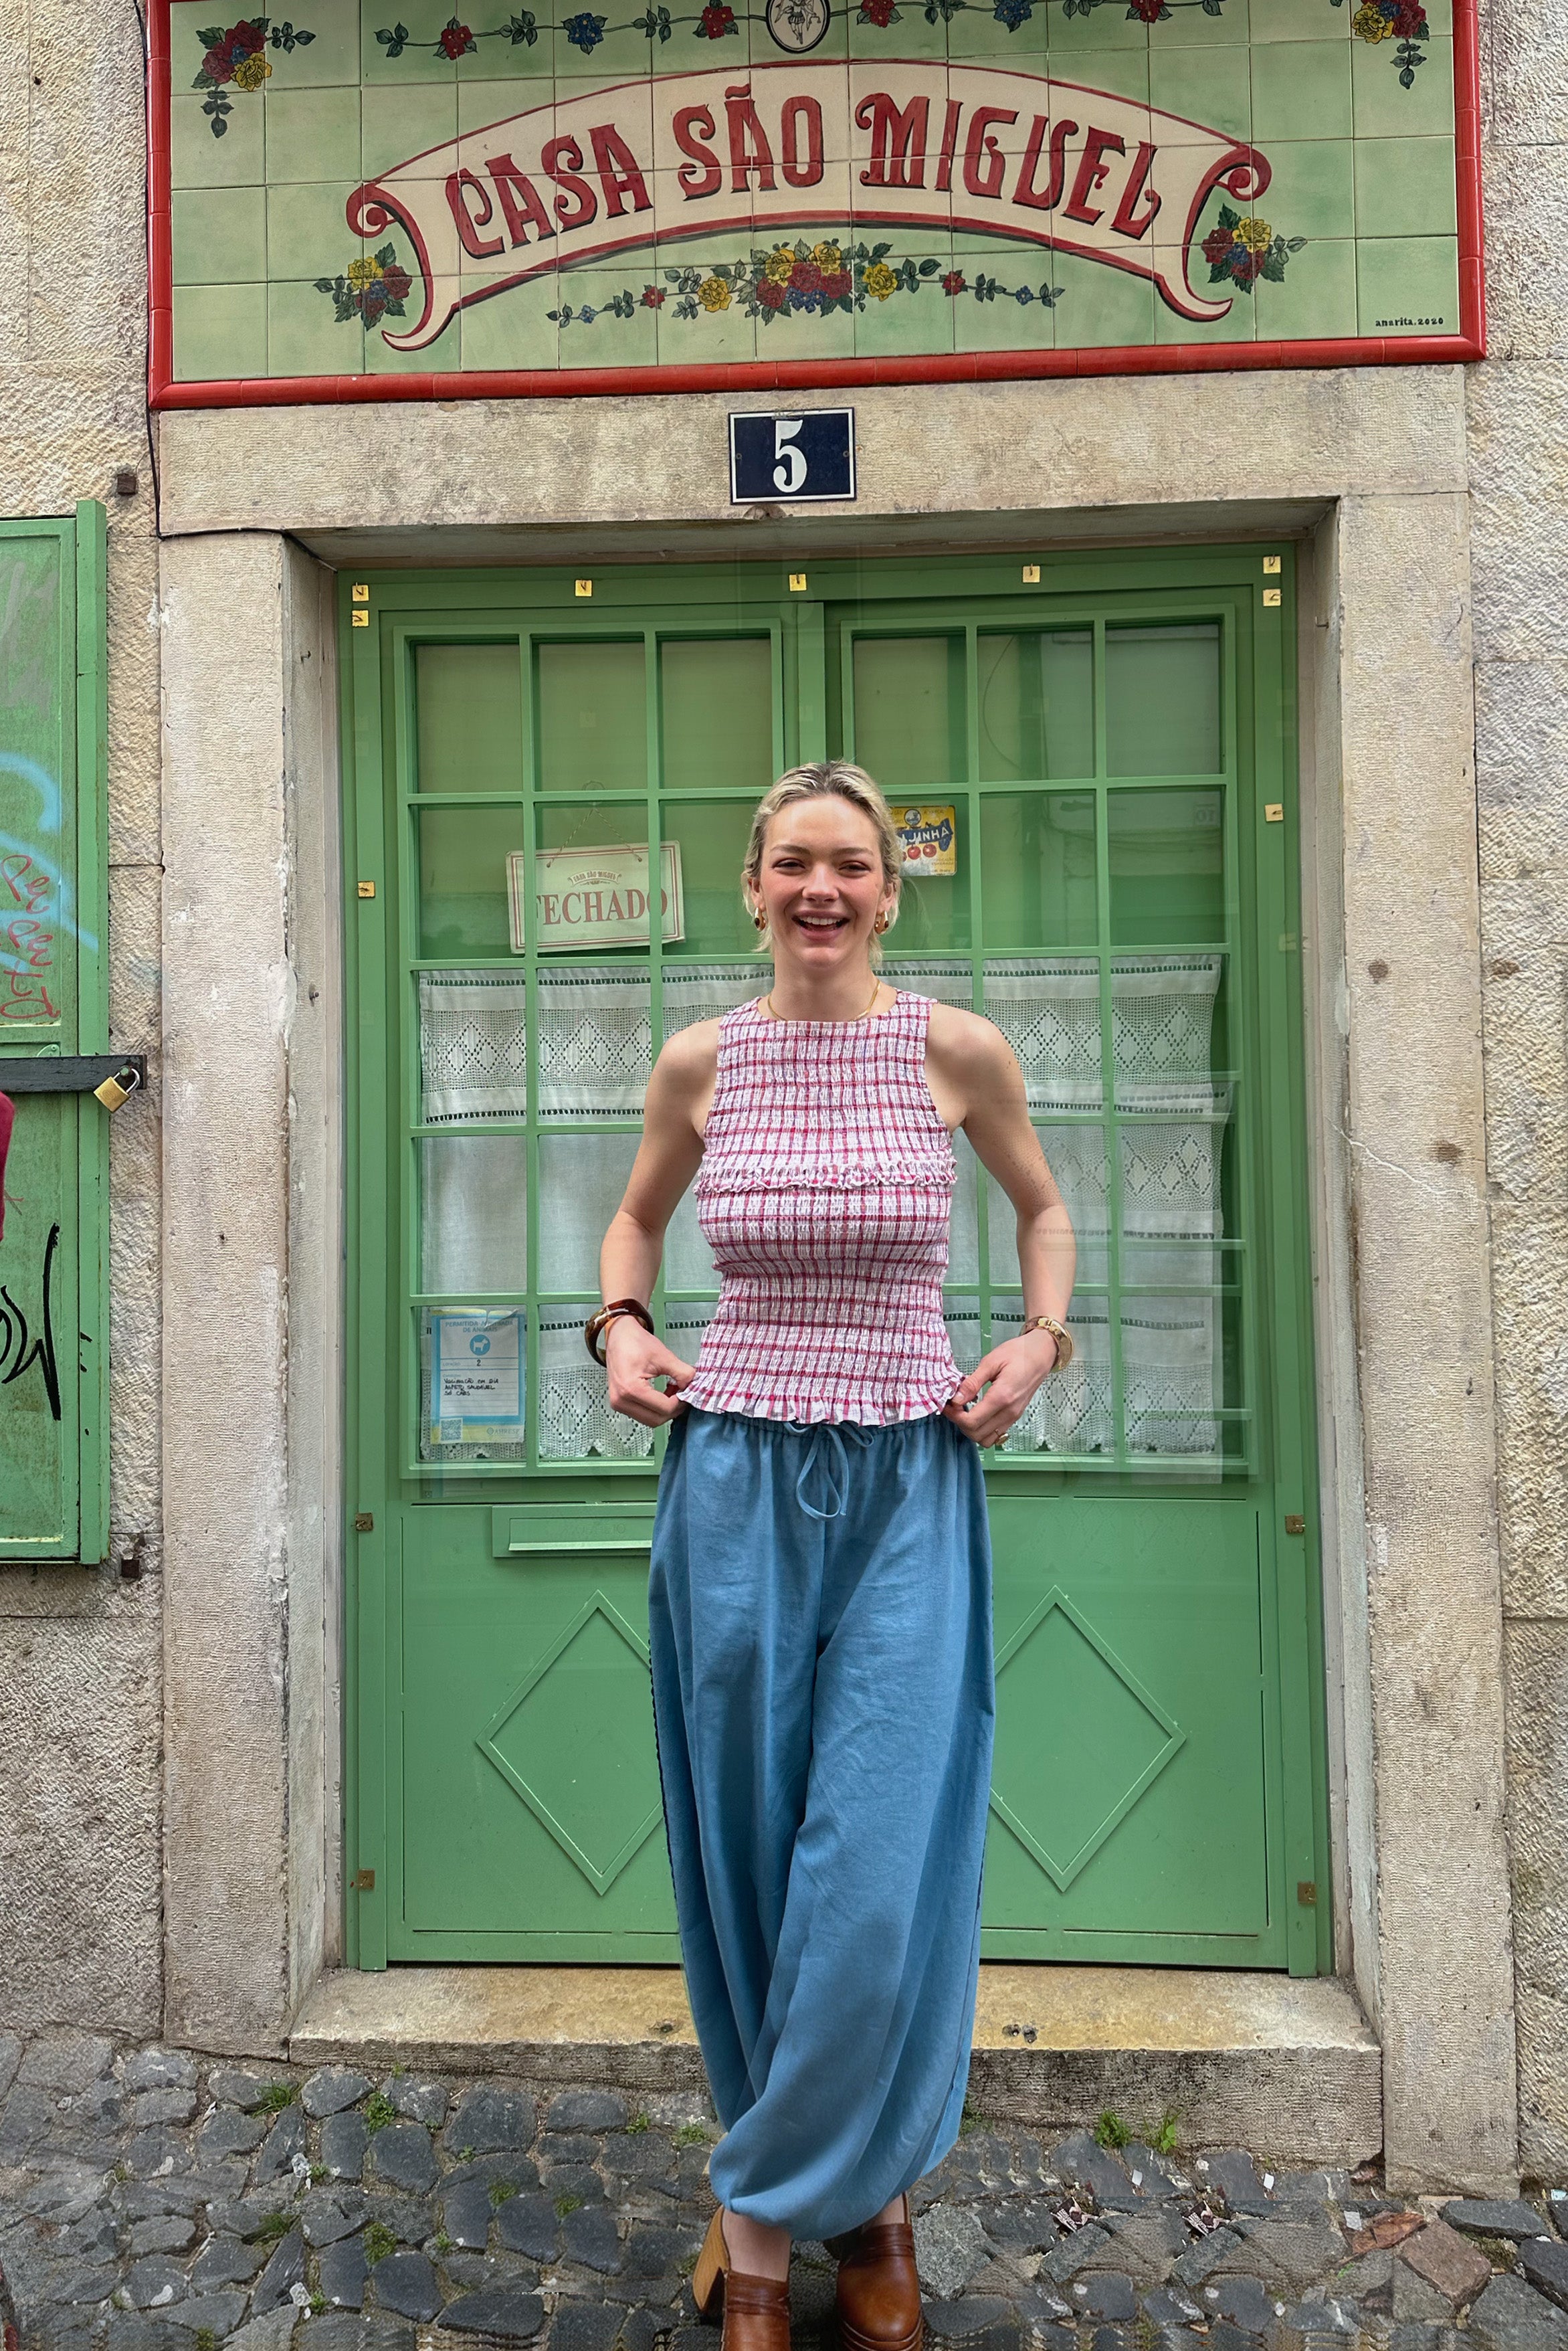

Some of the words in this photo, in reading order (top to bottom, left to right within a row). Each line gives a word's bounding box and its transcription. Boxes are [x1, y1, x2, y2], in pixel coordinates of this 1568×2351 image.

[445, 123, 654, 260] CASA
[672, 84, 825, 201] SÃO
[855, 92, 1162, 241] MIGUEL
[773, 419, 808, 493] 5
